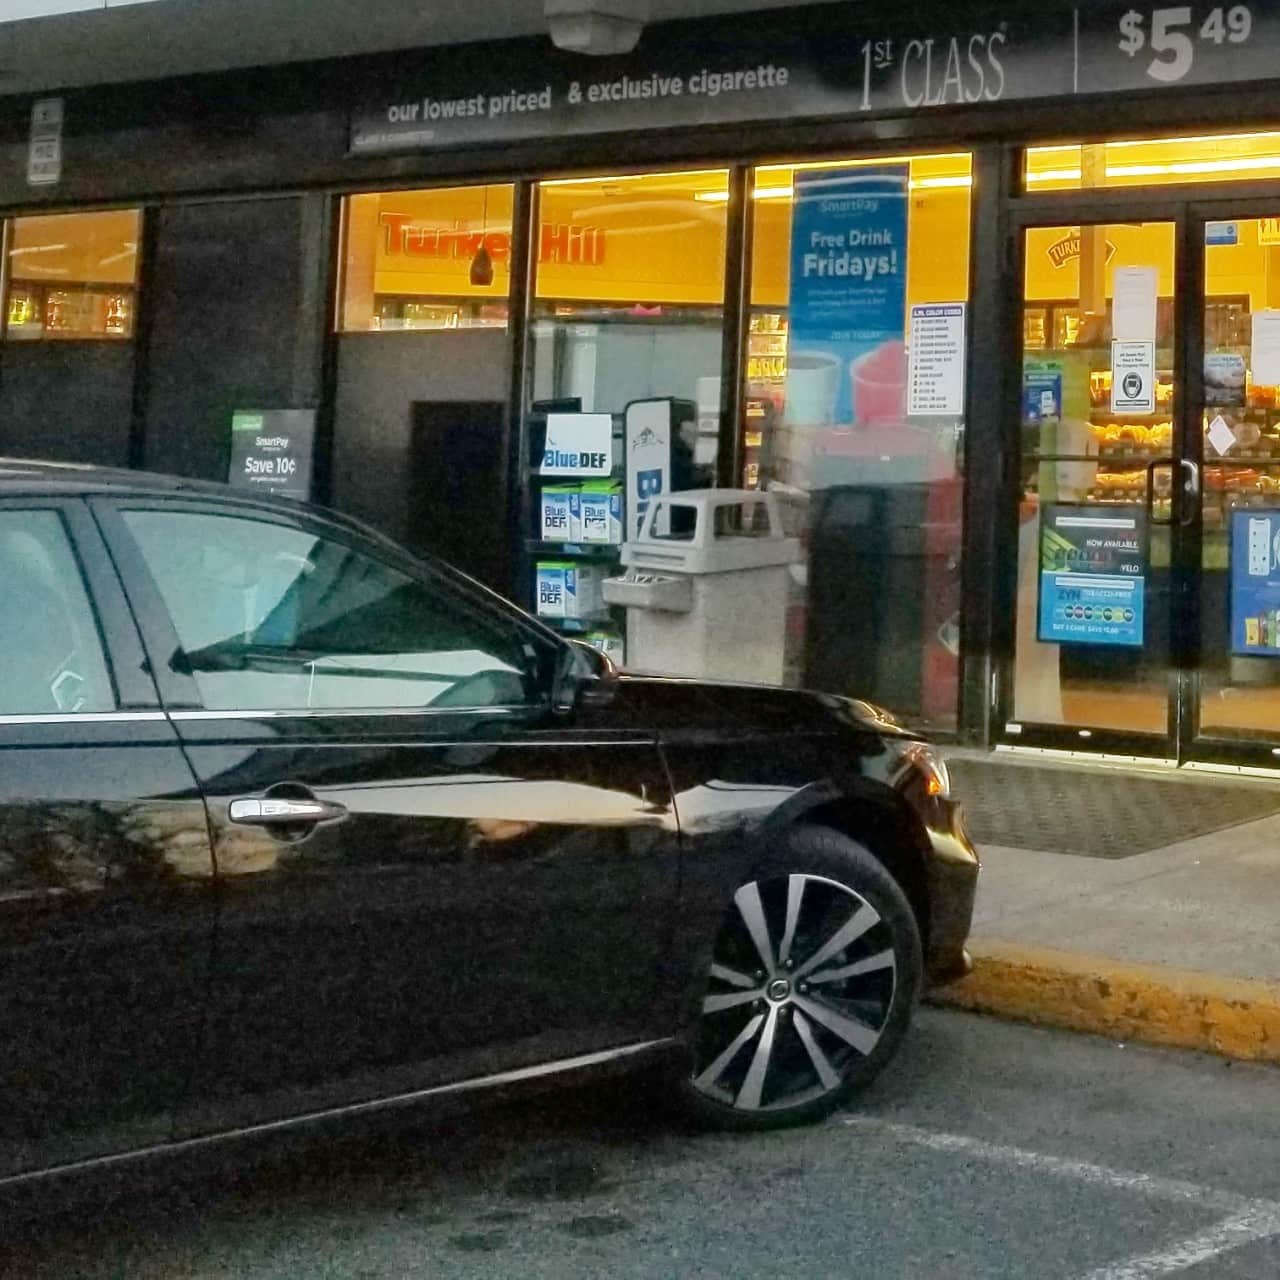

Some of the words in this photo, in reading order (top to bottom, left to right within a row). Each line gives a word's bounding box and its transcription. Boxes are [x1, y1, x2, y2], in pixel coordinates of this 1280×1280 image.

[901, 32, 1006, 108] CLASS
[387, 104, 419, 122] our
[423, 94, 484, 120] lowest
[489, 86, 552, 117] priced
[567, 81, 582, 104] &
[588, 72, 683, 103] exclusive
[688, 63, 789, 96] cigarette
[378, 211, 512, 266] Turke
[810, 230, 845, 248] Free
[848, 228, 893, 246] Drink
[803, 249, 898, 281] Fridays!
[255, 436, 289, 449] SmartPay
[244, 456, 274, 474] Save
[276, 457, 296, 476] 10¢
[544, 505, 567, 516] Blue
[584, 506, 606, 517] Blue
[544, 516, 567, 528] DEF
[539, 581, 561, 592] Blue
[539, 592, 562, 604] DEF
